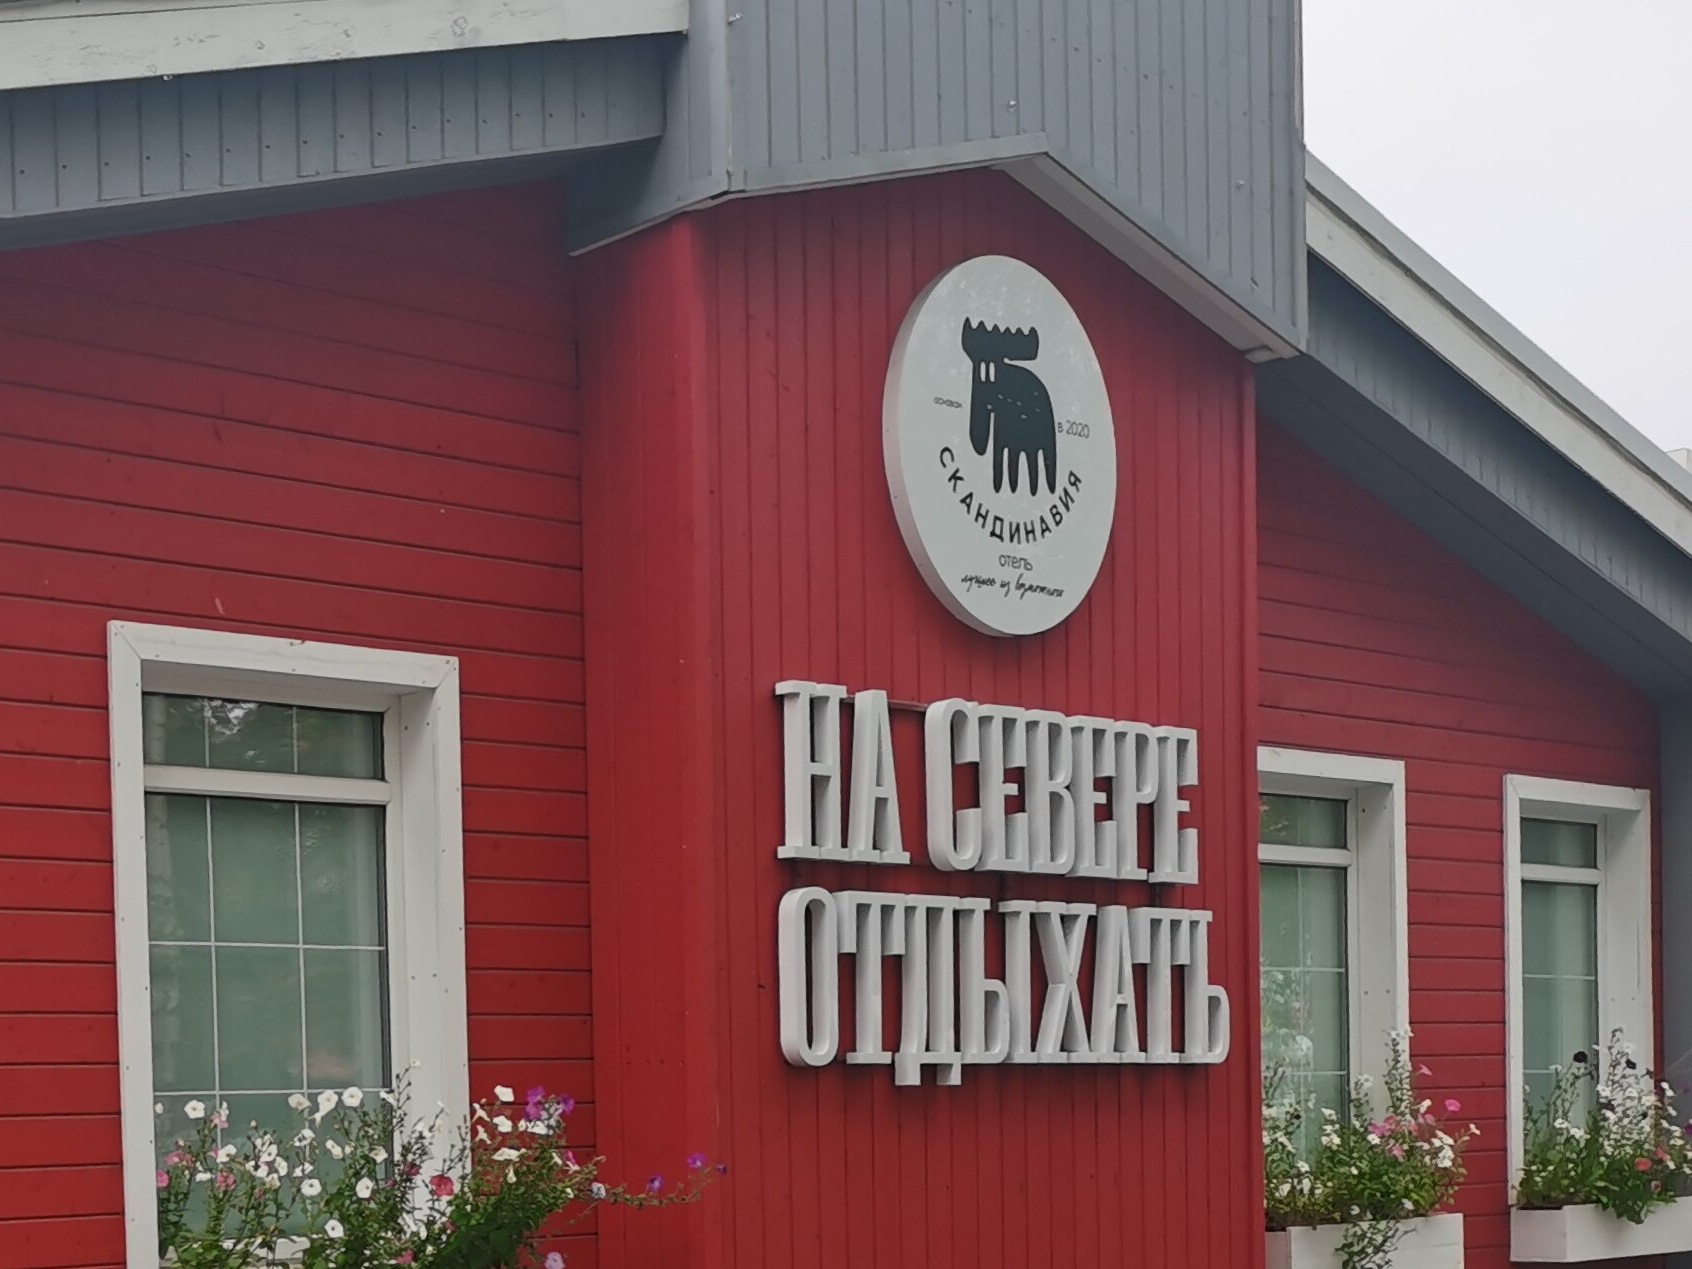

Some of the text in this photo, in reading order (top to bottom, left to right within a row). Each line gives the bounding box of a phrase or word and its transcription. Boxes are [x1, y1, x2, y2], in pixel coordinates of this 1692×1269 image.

[939, 446, 1083, 545] СКАНДИНАВИЯ
[1065, 419, 1091, 439] 2020
[774, 679, 1199, 885] НА СЕВЕРЕ
[778, 886, 1230, 1086] ОТДЫХАТЬ
